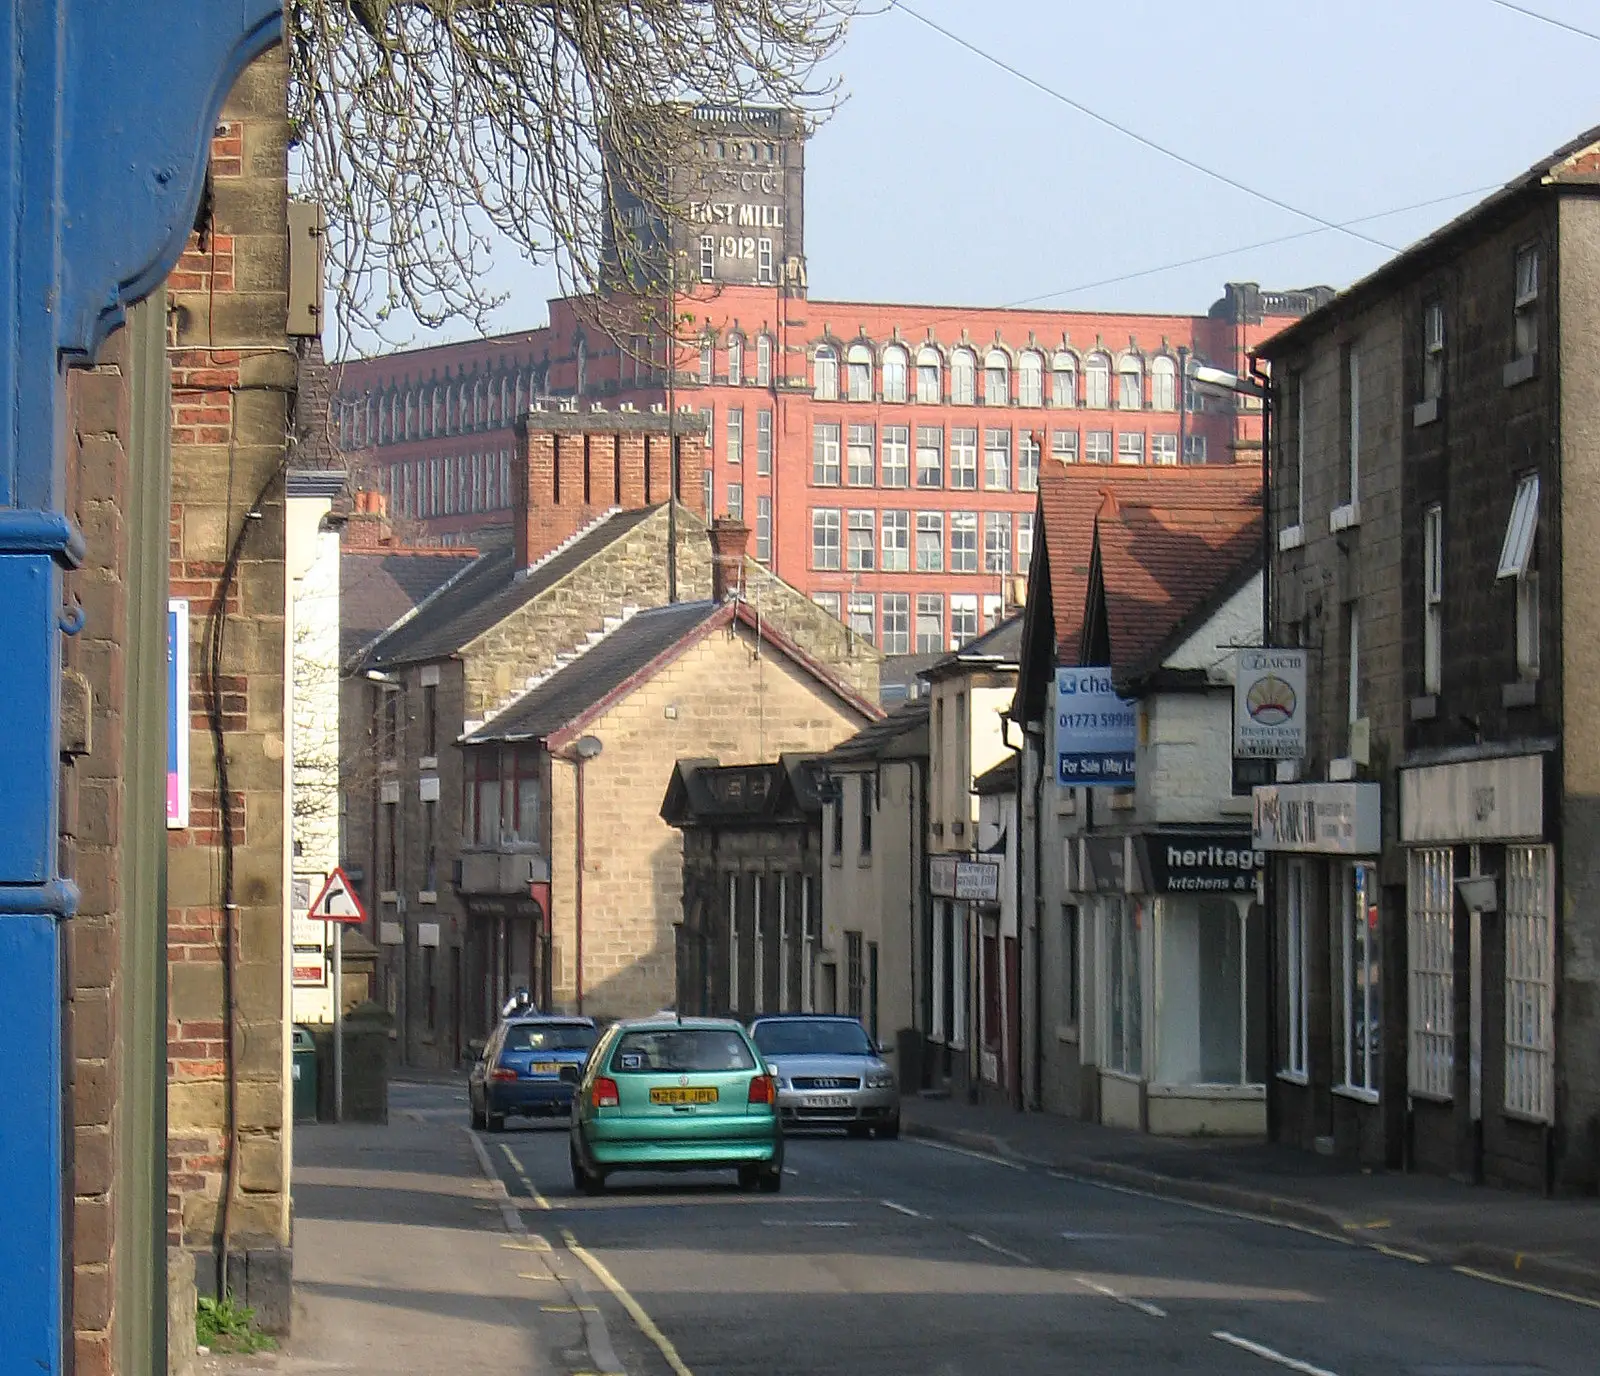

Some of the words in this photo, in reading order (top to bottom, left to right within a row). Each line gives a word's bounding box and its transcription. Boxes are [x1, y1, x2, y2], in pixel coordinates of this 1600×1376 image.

[690, 202, 734, 224] EAST
[739, 204, 784, 227] MILL
[719, 236, 755, 259] 1912
[1060, 714, 1097, 729] 01773
[1062, 759, 1077, 774] For
[1080, 759, 1100, 775] Sale
[1167, 846, 1265, 870] heritage
[1168, 876, 1230, 890] kitchens
[1234, 876, 1246, 889] &
